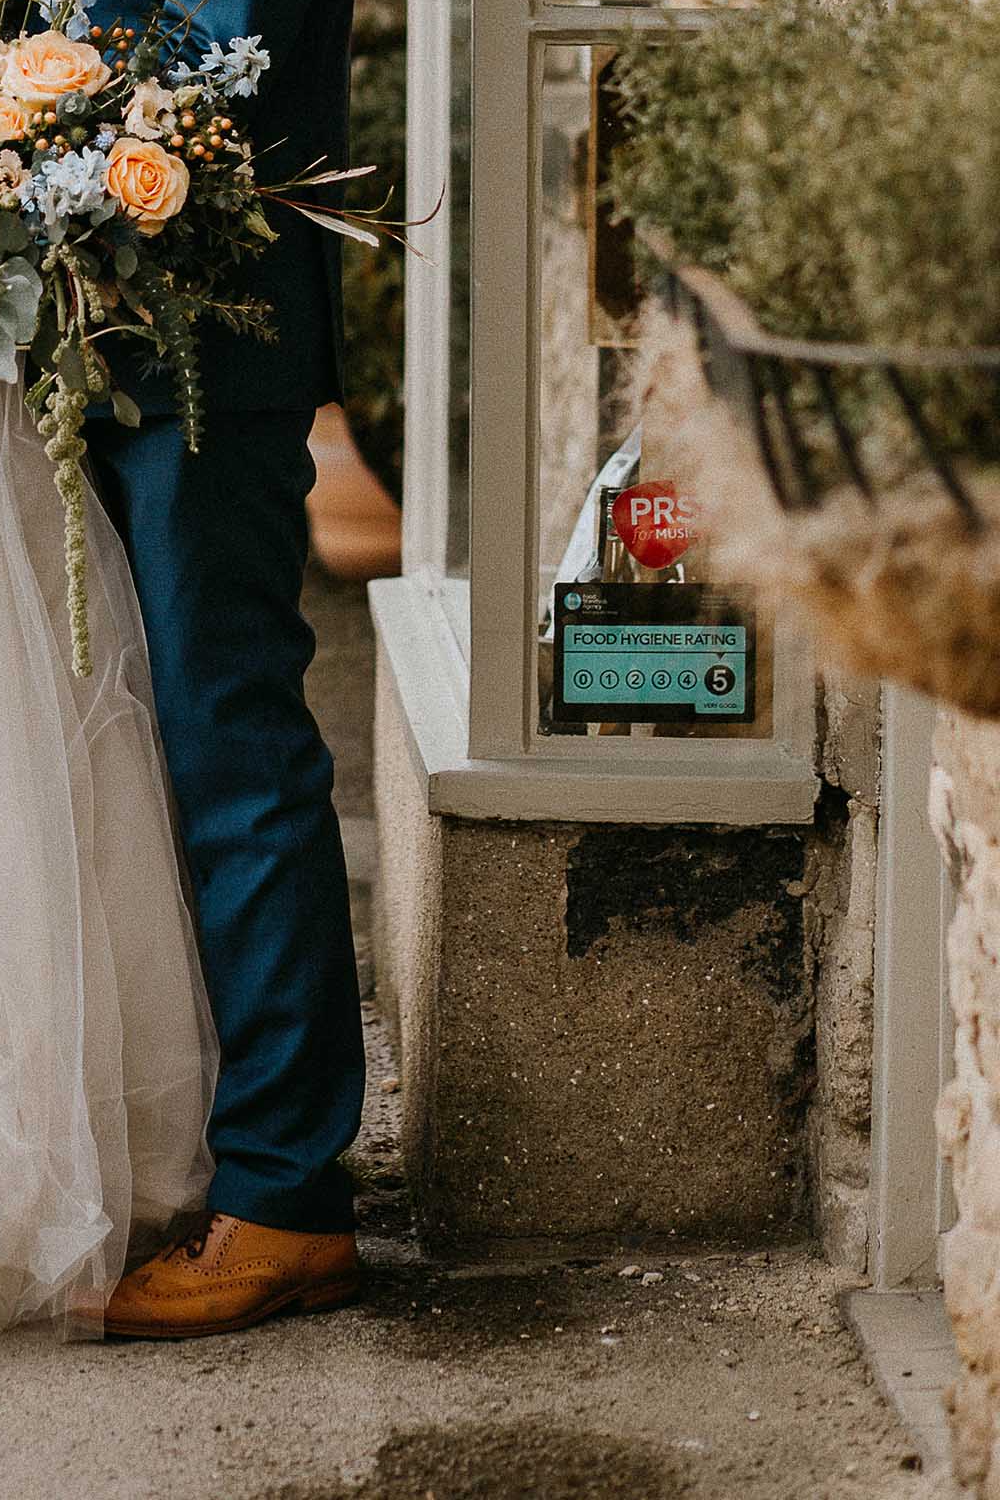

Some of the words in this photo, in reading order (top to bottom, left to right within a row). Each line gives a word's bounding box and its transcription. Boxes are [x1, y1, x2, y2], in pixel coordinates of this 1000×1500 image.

[630, 496, 697, 526] PRS
[632, 525, 655, 544] for
[573, 633, 617, 645] FOOD
[620, 633, 682, 645] HYGIENE
[685, 633, 737, 646] RATING
[579, 673, 588, 685] 0
[631, 673, 640, 685] 2
[657, 673, 666, 685] 3
[683, 673, 692, 685] 4
[711, 669, 728, 691] 5
